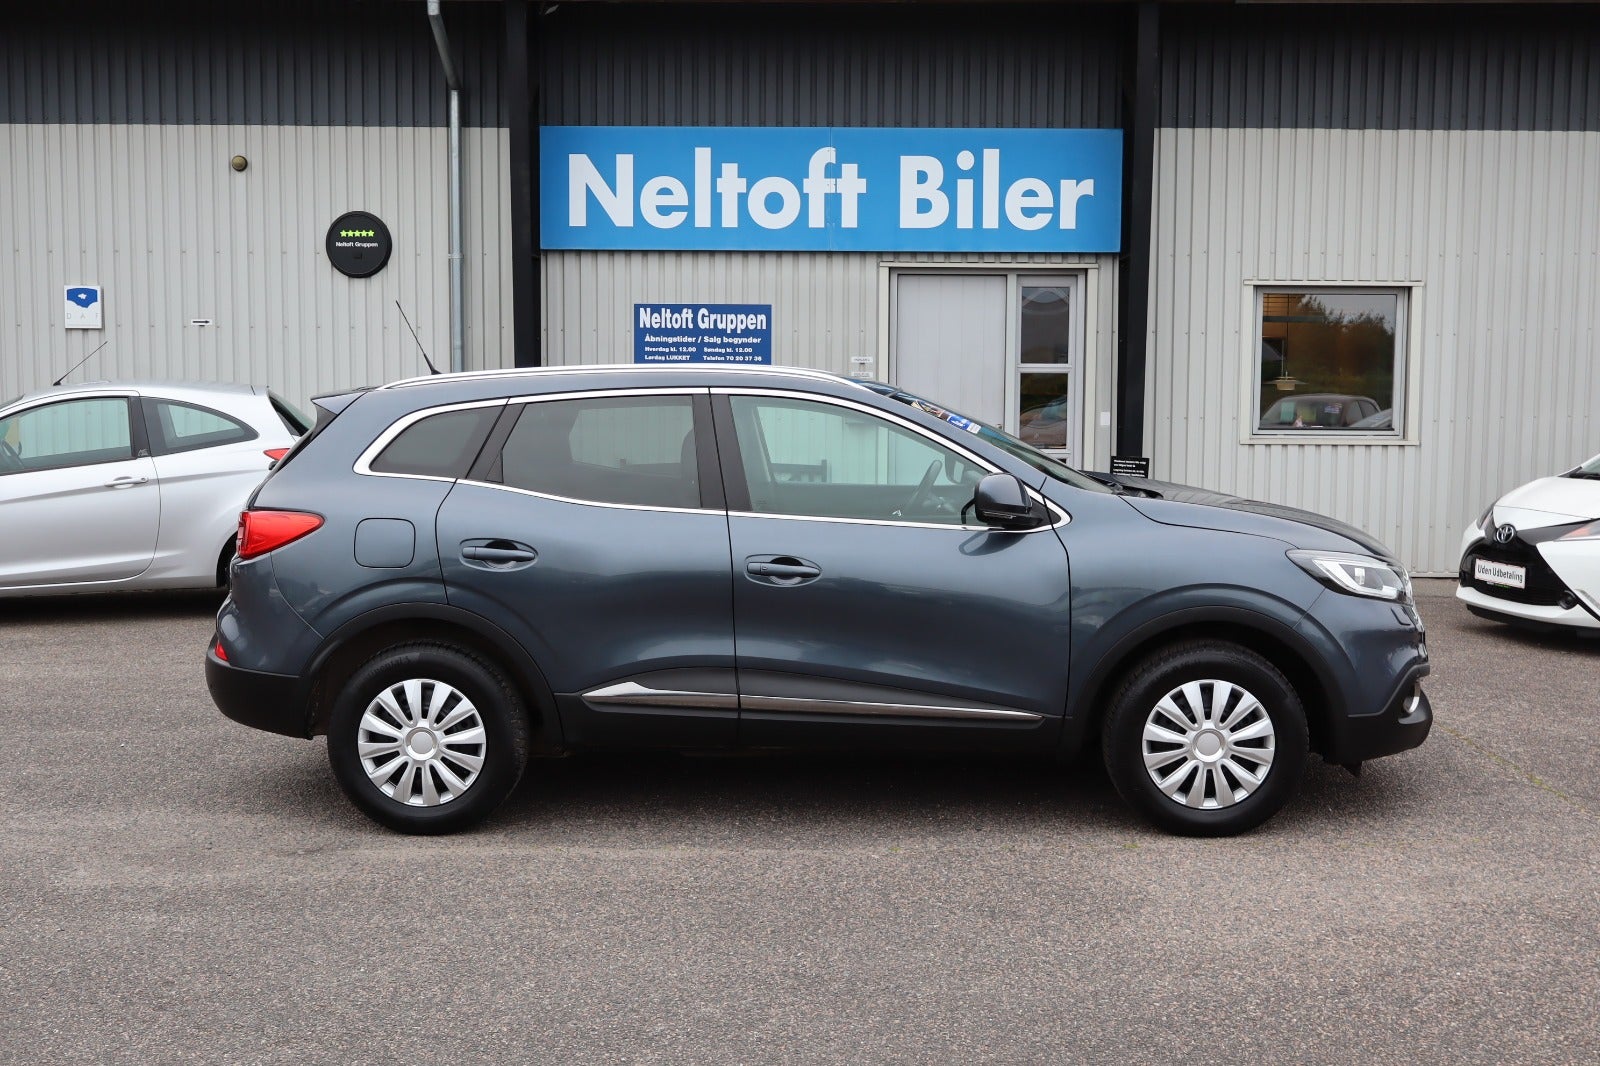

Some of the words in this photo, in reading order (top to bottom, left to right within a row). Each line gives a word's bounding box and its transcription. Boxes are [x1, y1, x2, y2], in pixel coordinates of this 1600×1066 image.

[568, 147, 867, 230] Neltoft
[899, 149, 1095, 231] Biler
[639, 307, 694, 329] Neltoft
[697, 307, 767, 334] Gruppen
[644, 333, 697, 343] Åbningstider
[703, 336, 722, 344] Salg
[723, 336, 762, 344] begynder
[1478, 564, 1492, 576] Uden
[1492, 568, 1522, 584] Udbetaling
